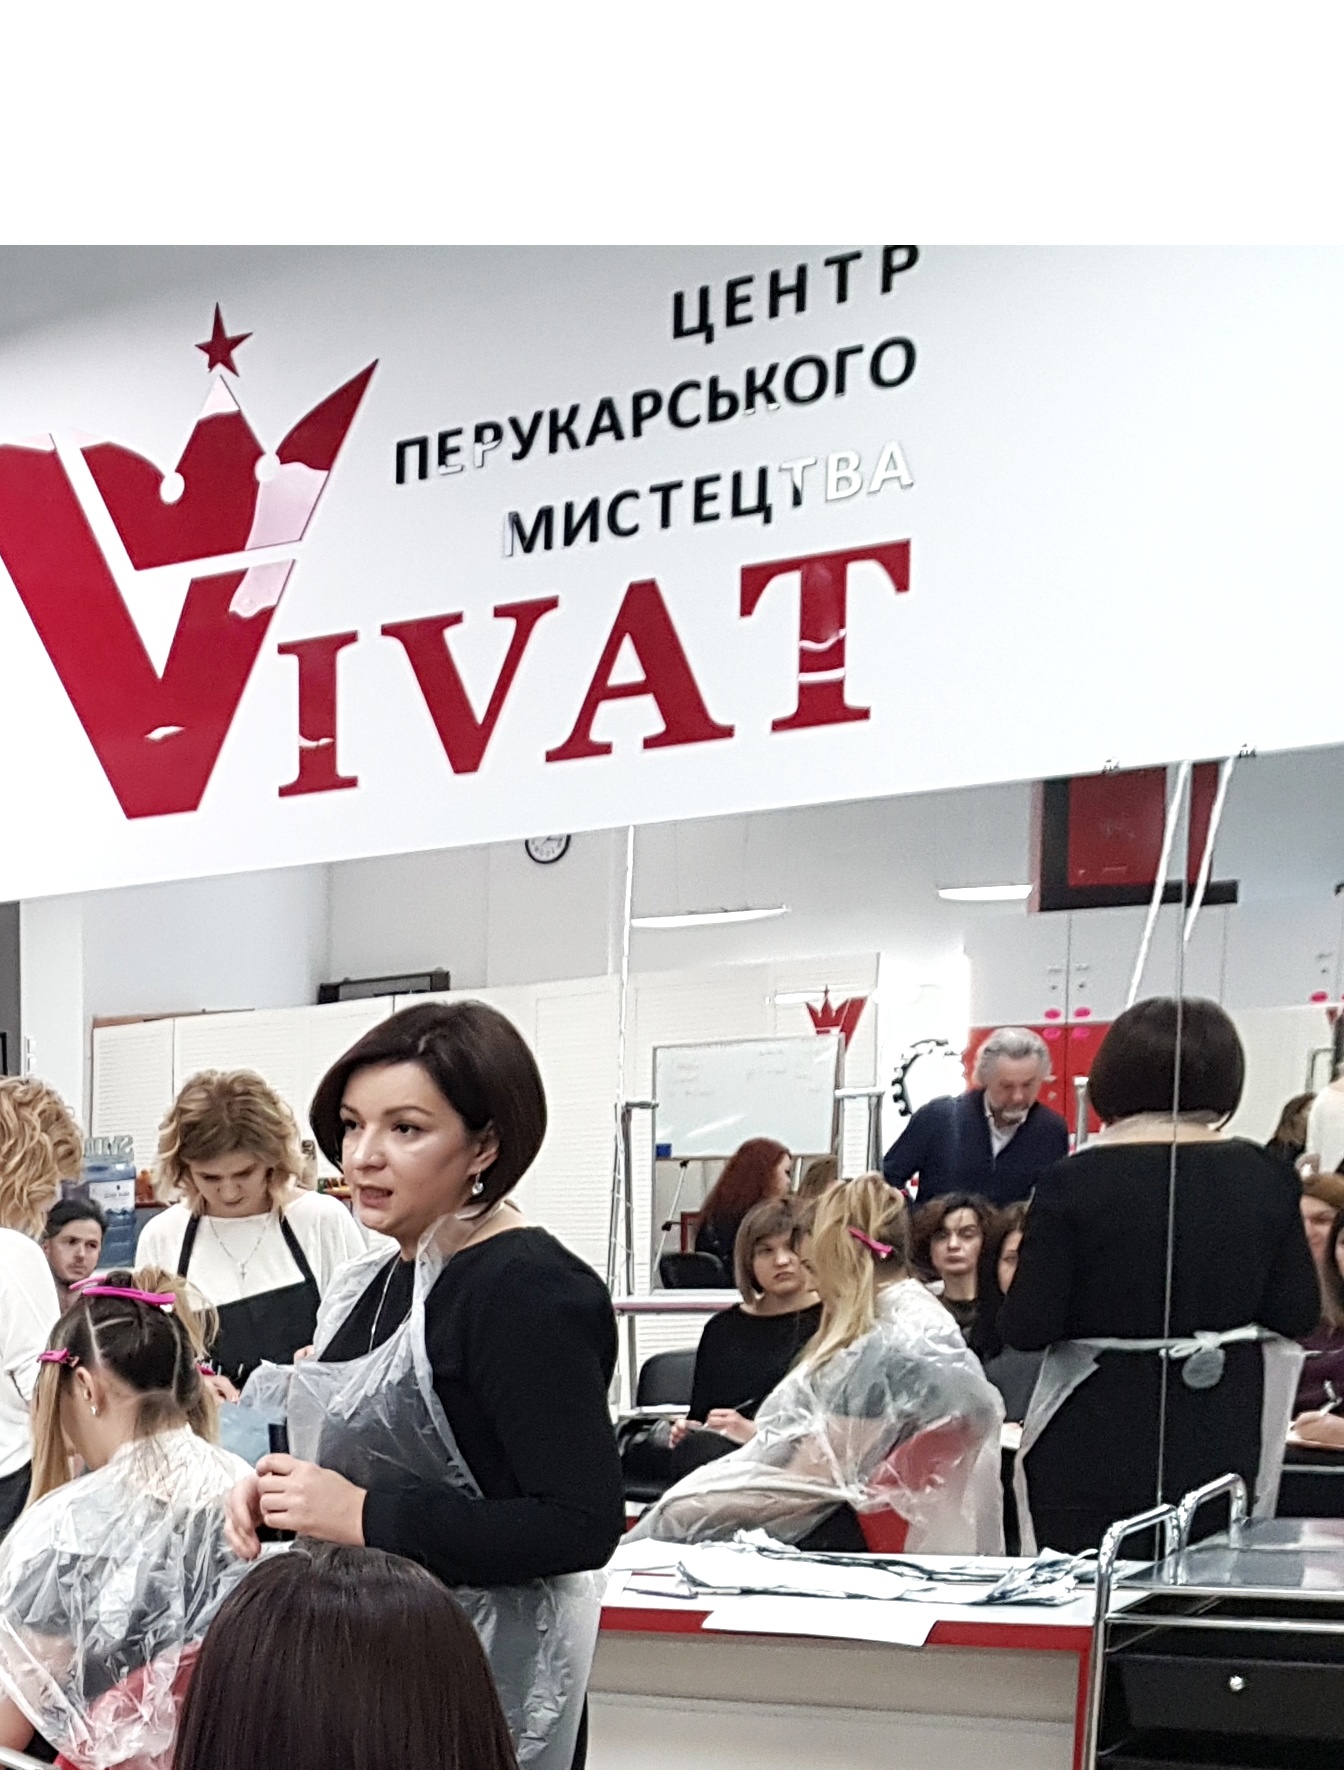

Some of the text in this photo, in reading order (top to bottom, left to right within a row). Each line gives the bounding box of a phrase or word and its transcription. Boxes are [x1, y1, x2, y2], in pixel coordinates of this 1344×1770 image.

[670, 244, 919, 342] ЦЕНТР
[394, 334, 916, 485] ПЕРУКАРСЬКОГО
[503, 438, 915, 557] МИСТЕЦТВА
